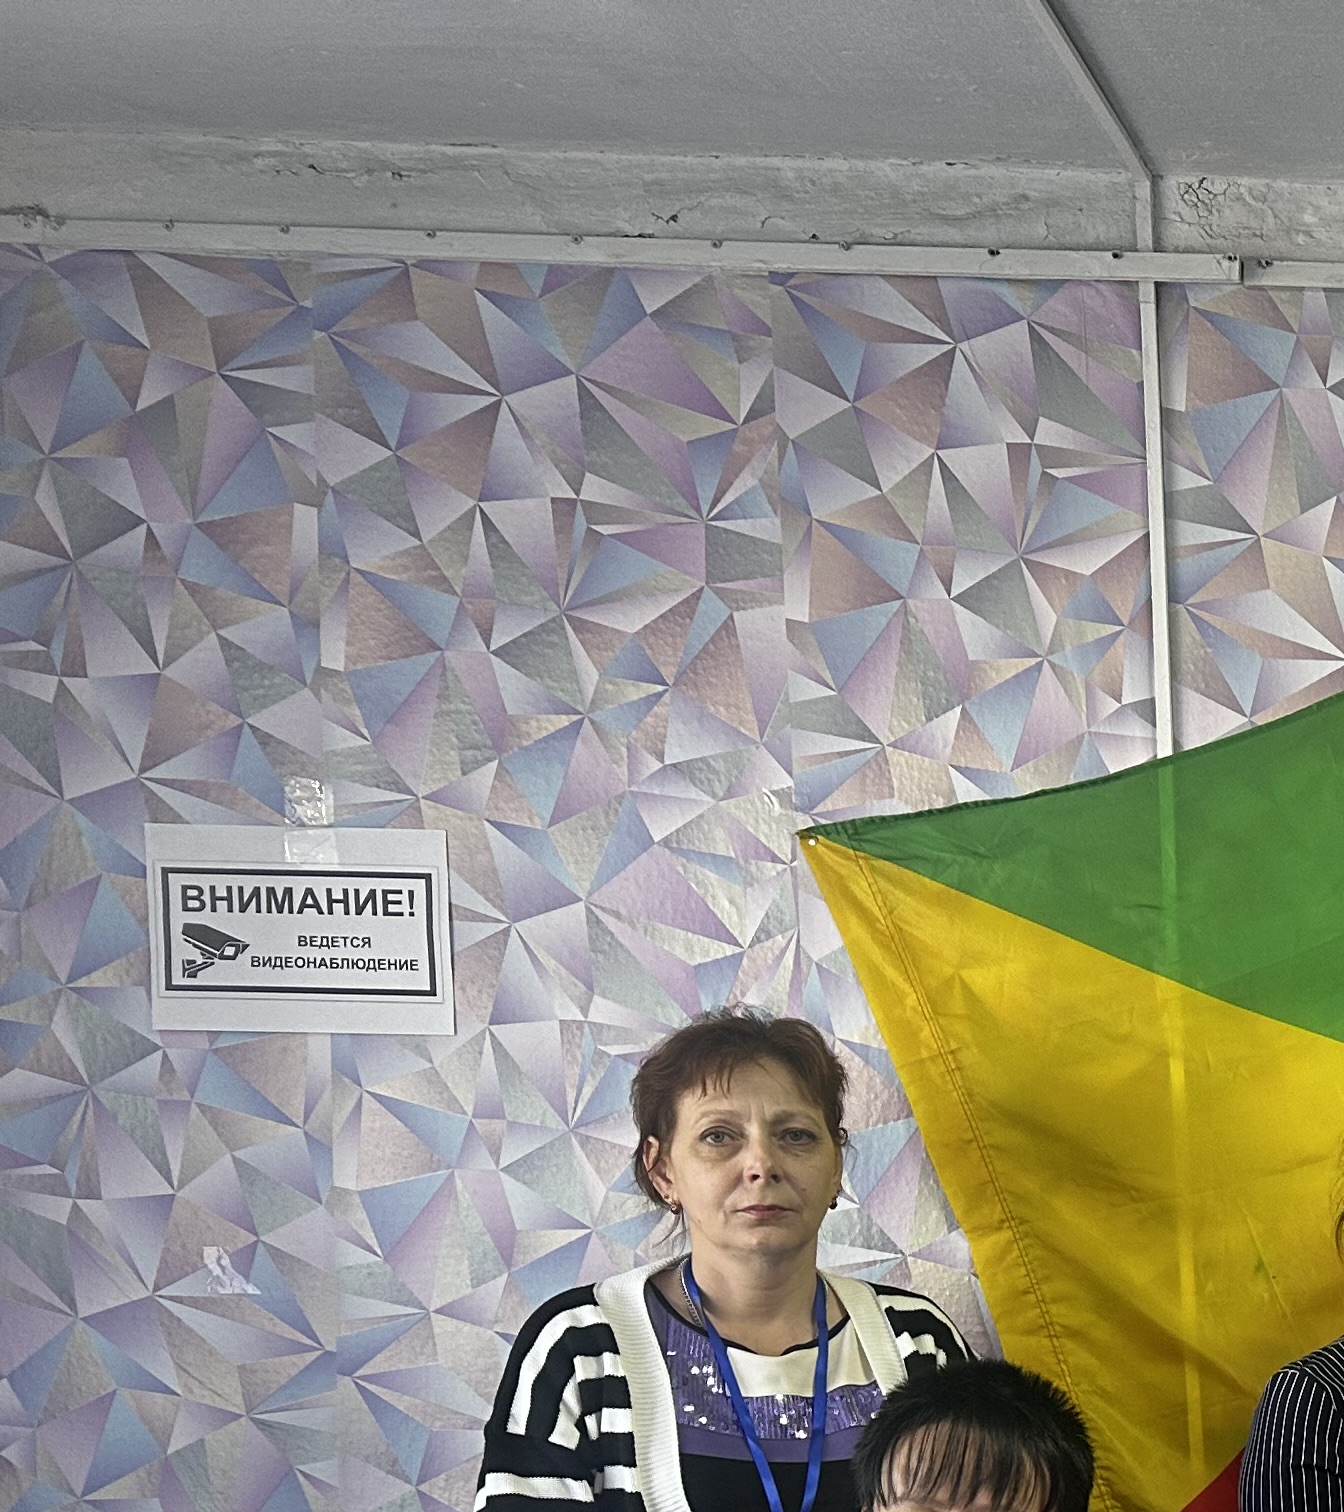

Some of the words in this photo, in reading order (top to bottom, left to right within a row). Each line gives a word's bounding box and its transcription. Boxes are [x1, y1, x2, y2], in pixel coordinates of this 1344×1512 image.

[181, 884, 416, 918] ВНИМАНИЕ!
[297, 935, 372, 949] ВЕДЕТСЯ
[250, 955, 420, 972] ВИДЕОНАБЛЮДЕНИЕ
